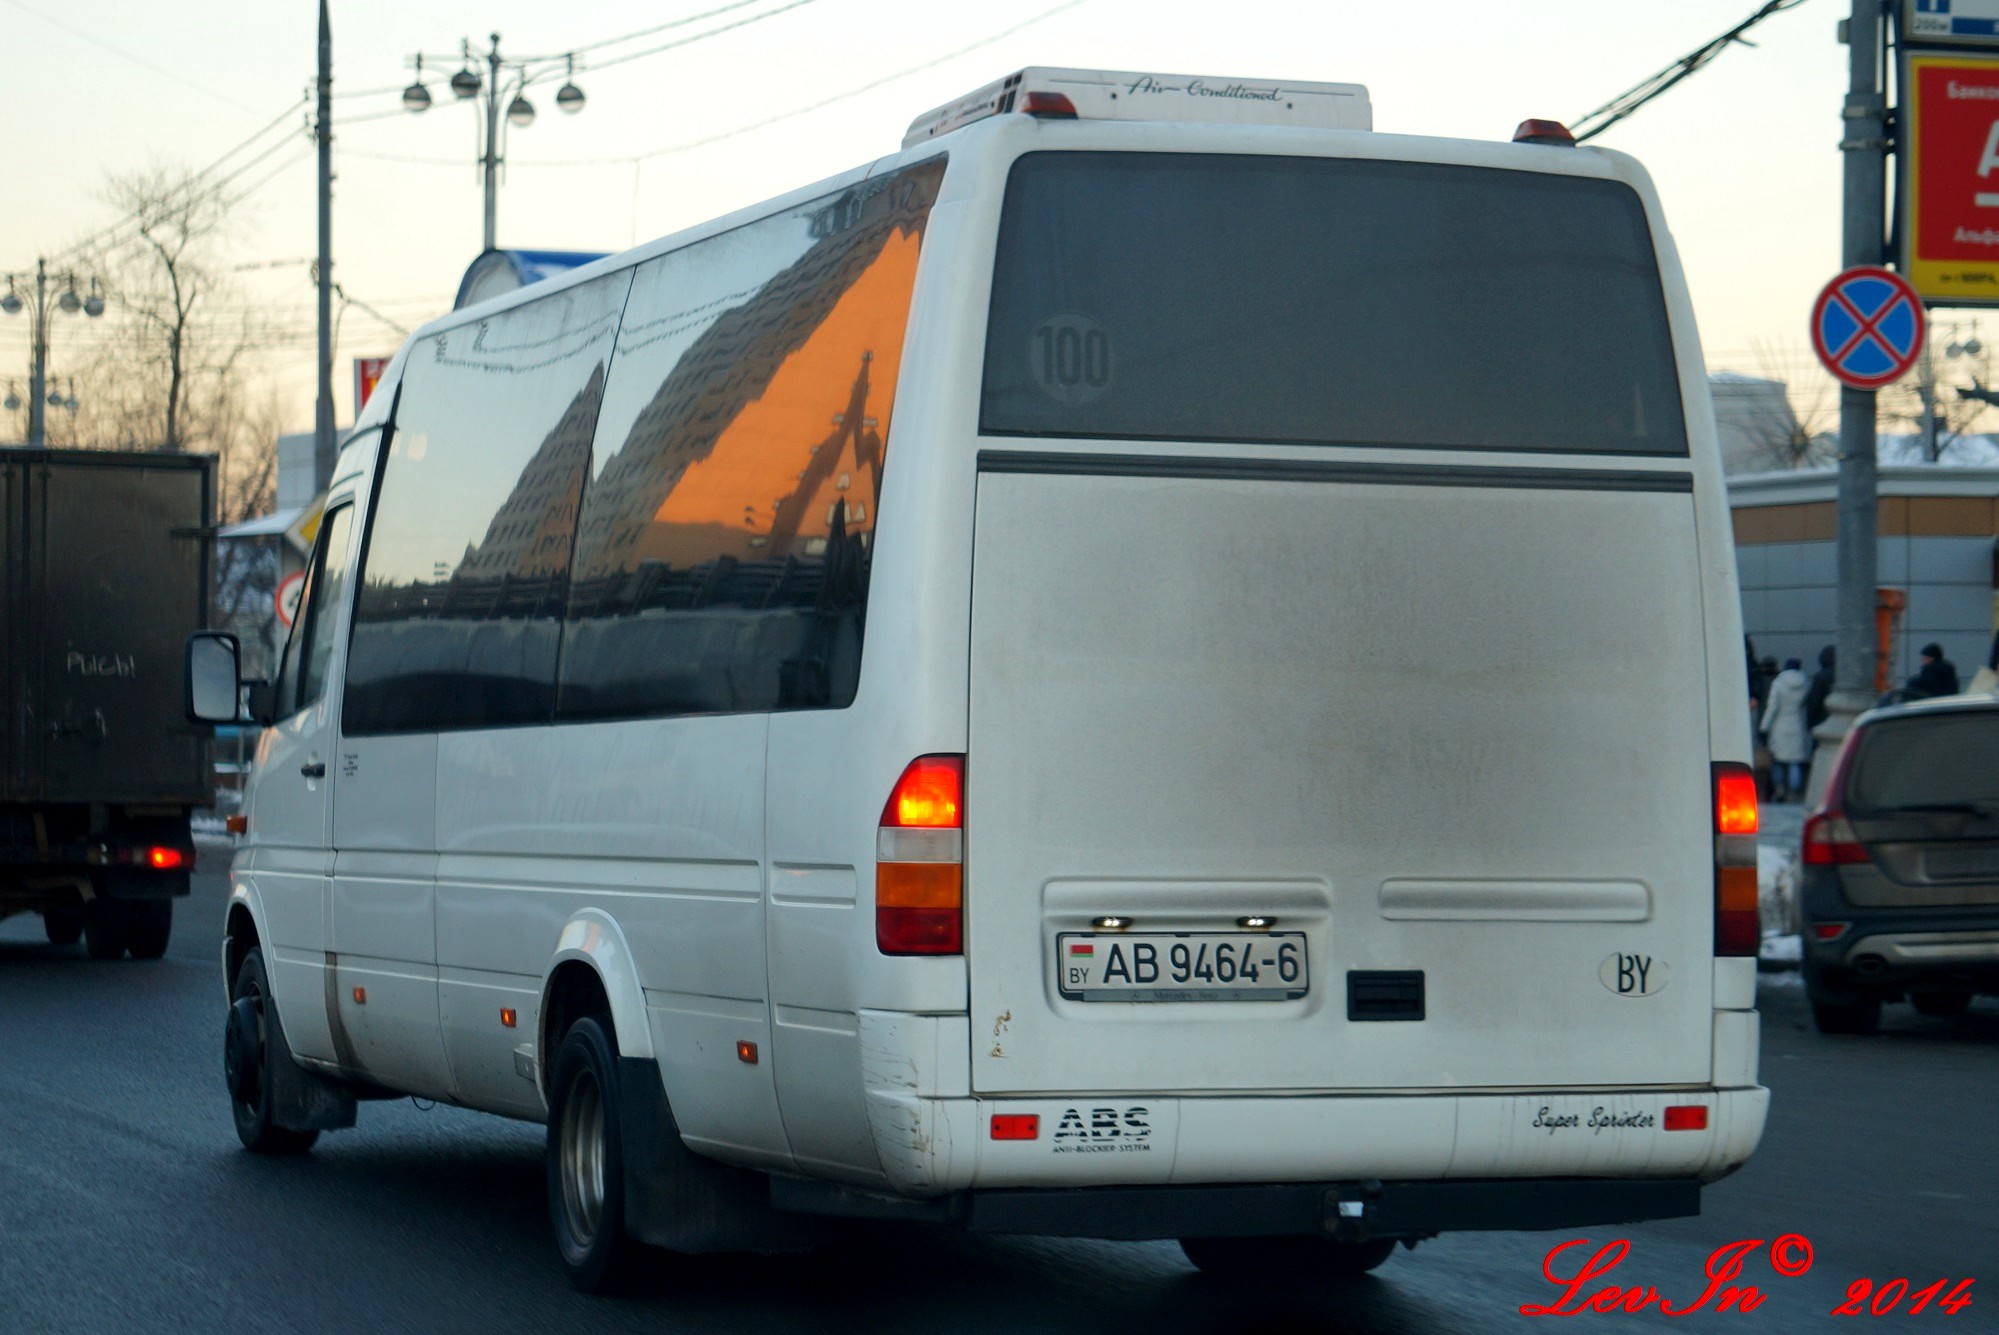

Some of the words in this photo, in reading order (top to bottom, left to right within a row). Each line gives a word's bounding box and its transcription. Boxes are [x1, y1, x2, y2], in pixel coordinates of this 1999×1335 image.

[1127, 75, 1165, 96] Air
[1187, 79, 1283, 102] Conditioned
[1036, 325, 1109, 388] 100
[1070, 967, 1090, 984] BY
[1102, 942, 1160, 984] AB
[1170, 942, 1299, 984] 9464-6
[1617, 953, 1652, 994] BY
[1053, 1106, 1151, 1143] ABS
[1533, 1106, 1580, 1136] Super
[1588, 1106, 1656, 1136] Sprinter
[1119, 1143, 1151, 1152] SYSTEM
